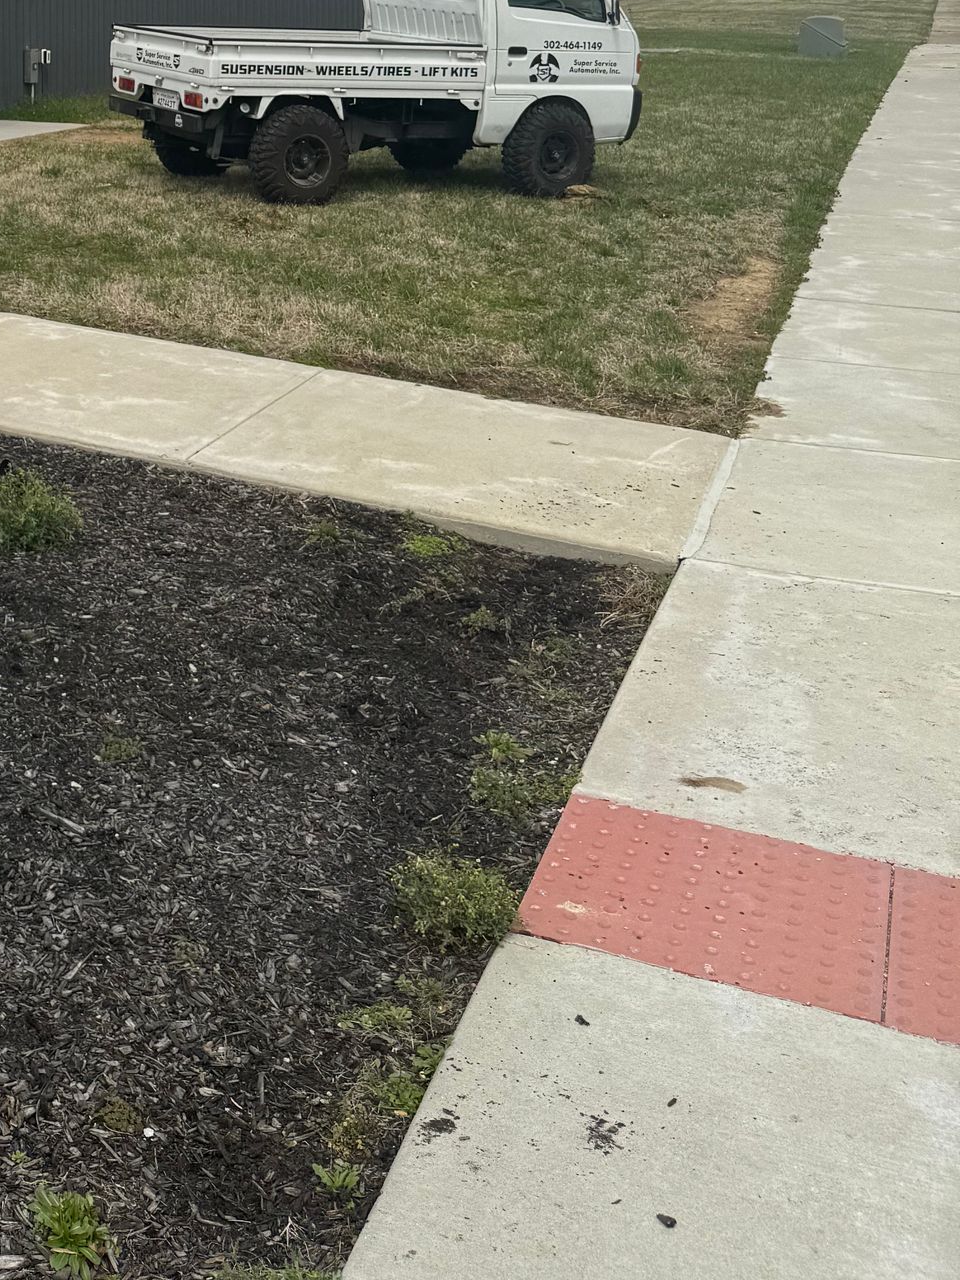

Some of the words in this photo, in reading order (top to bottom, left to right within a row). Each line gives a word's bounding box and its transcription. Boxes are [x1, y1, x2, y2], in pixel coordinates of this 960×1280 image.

[543, 40, 603, 50] 302-464-1149
[144, 50, 157, 58] Super
[157, 52, 171, 61] Service
[188, 67, 205, 75] 4WD
[221, 64, 304, 76] SUSPENSION
[315, 65, 411, 77] WHEELS/TIRES
[421, 66, 448, 77] LIFT
[451, 66, 478, 78] KITS
[569, 66, 607, 75] Automotive,
